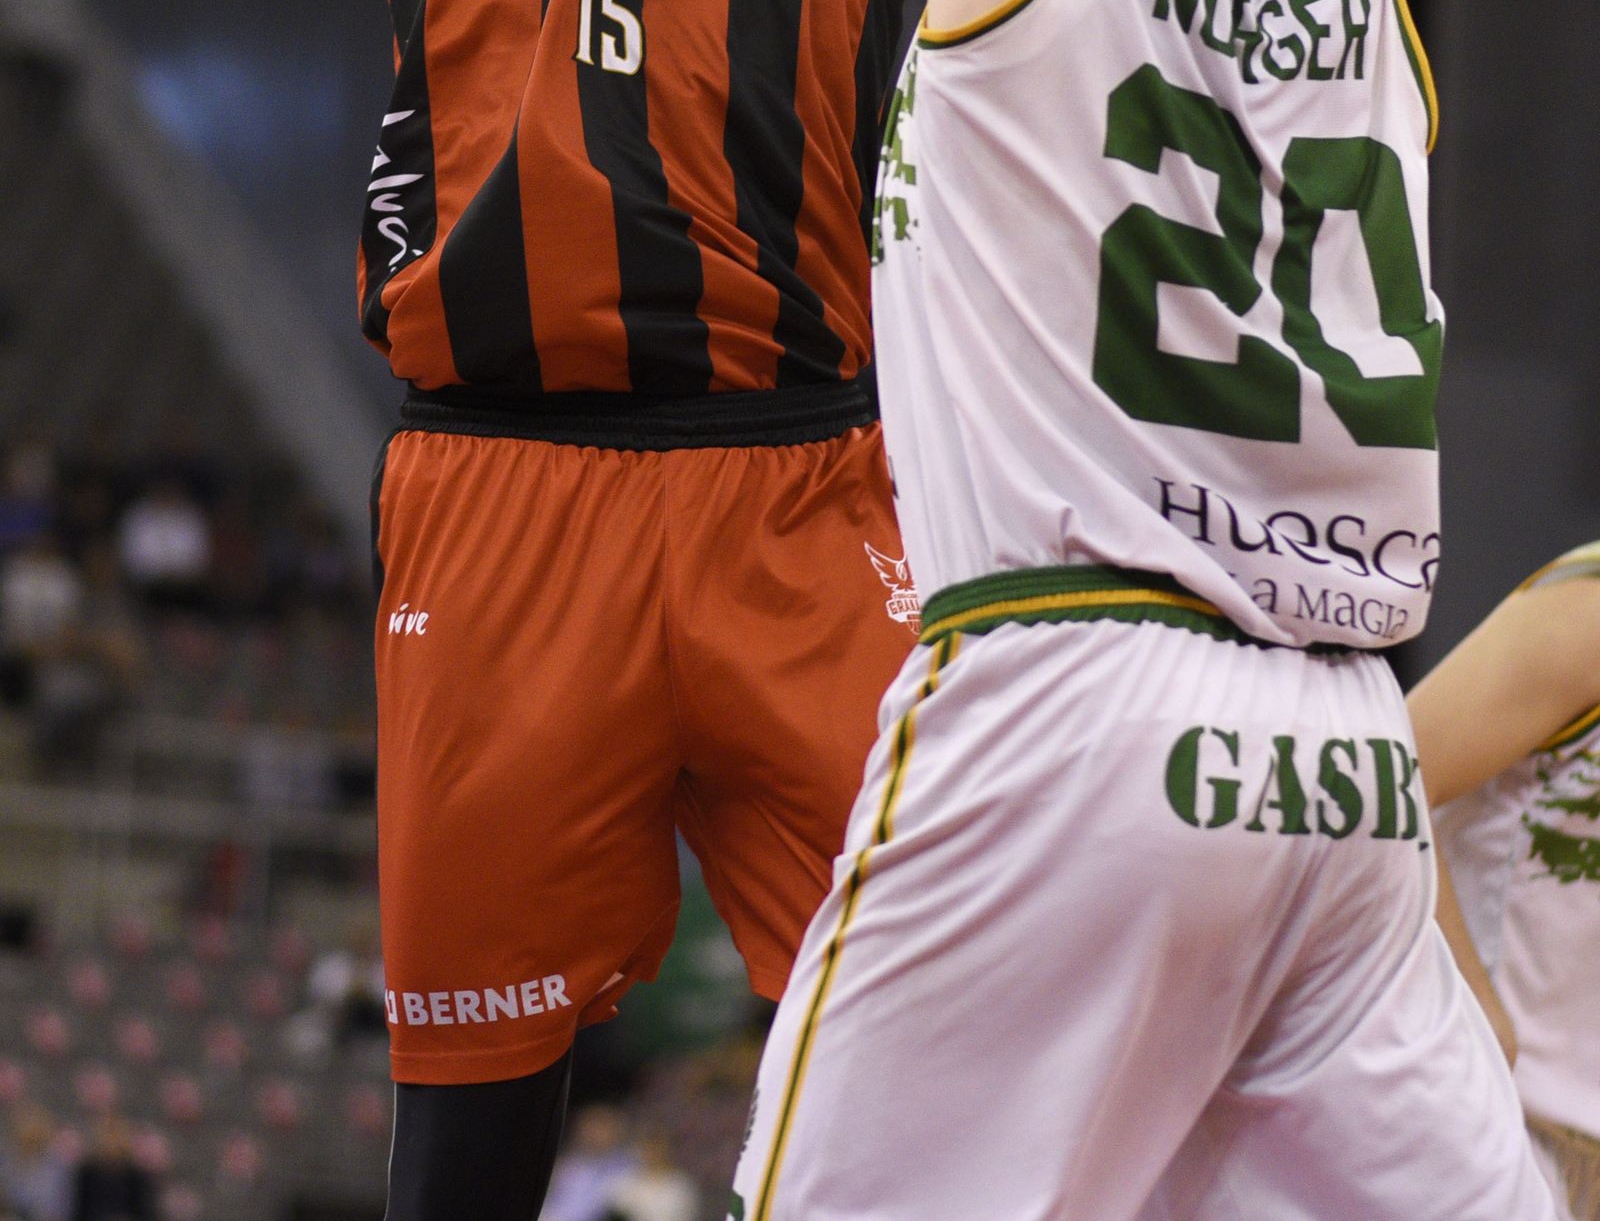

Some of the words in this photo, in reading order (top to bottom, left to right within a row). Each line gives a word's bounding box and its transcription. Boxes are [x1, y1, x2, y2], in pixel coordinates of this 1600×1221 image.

[1092, 62, 1443, 451] 20
[1164, 725, 1430, 852] GASB
[402, 973, 573, 1026] BERNER
